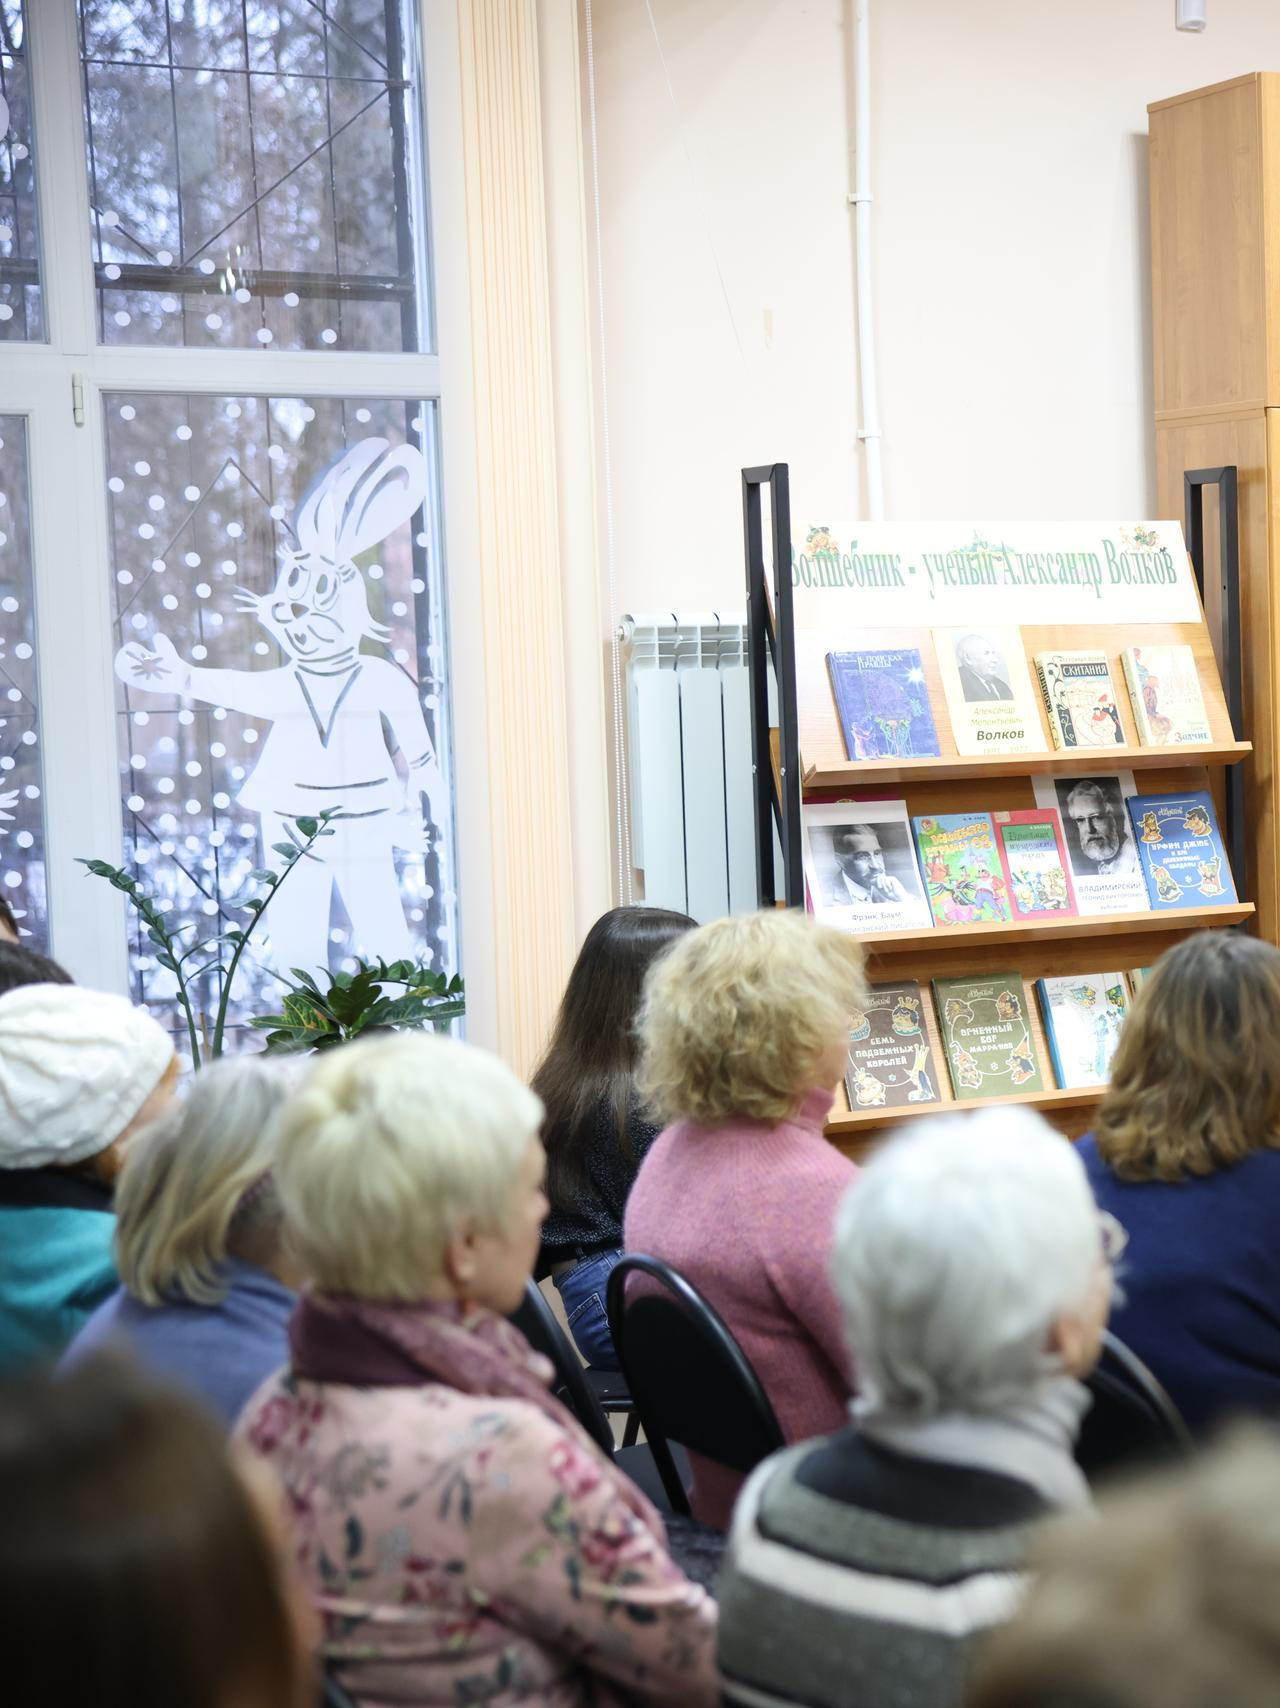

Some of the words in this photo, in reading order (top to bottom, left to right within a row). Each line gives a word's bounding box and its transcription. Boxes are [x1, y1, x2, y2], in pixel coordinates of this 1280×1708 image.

[1001, 541, 1102, 599] Александр
[1101, 539, 1177, 585] Волков
[1063, 664, 1107, 676] СКИТАНИЯ
[977, 730, 1025, 741] Волков
[1151, 842, 1180, 851] УРФИН
[1183, 839, 1210, 849] ДЖЮС
[1079, 882, 1141, 893] ВЛАДИМИРСКИЙ
[852, 913, 876, 921] Фрэнк
[881, 911, 901, 919] Баум
[960, 1022, 1013, 1037] ОГНЕННЫЙ
[870, 1036, 896, 1046] СЕМЬ
[980, 1034, 997, 1043] БОГ
[855, 1045, 914, 1059] ПОДЗЕМНЫХ
[970, 1042, 1014, 1053] МАРРАНОВ
[866, 1056, 908, 1068] КОРОЛЕЙ
